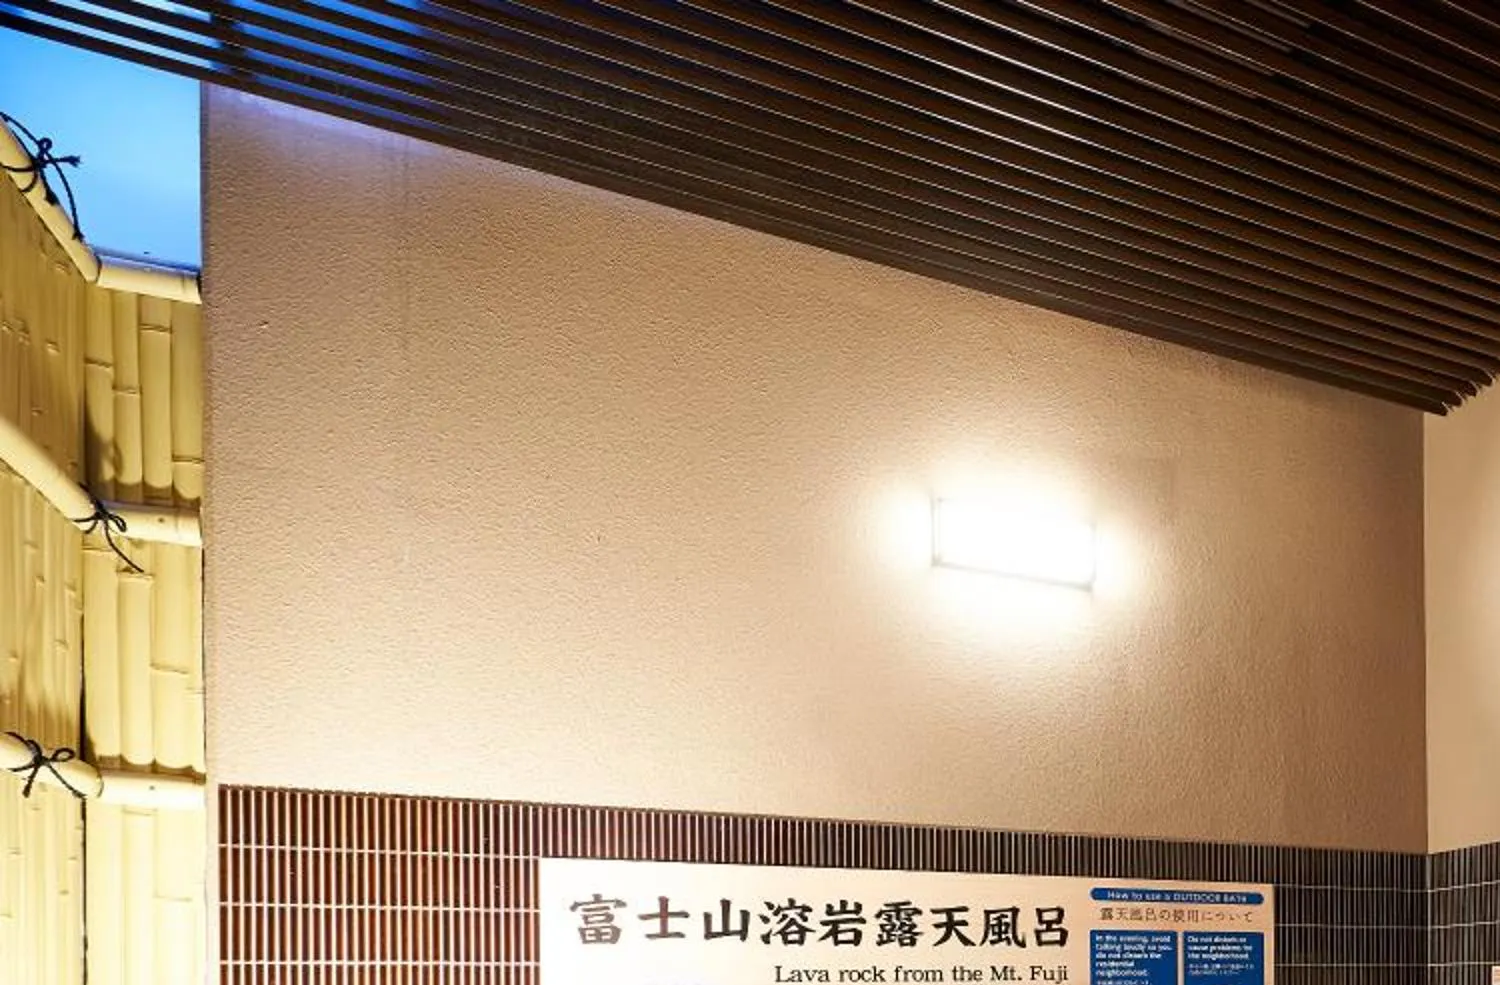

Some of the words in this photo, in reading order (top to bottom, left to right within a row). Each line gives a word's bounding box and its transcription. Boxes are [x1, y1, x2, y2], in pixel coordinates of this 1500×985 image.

[1107, 891, 1129, 900] How
[1131, 892, 1143, 900] to
[569, 893, 1071, 949] 富士山溶岩露天風呂
[1100, 907, 1254, 923] 露天風呂の使用について
[775, 965, 831, 984] Lava
[838, 964, 886, 984] rock
[894, 964, 944, 983] from
[951, 964, 984, 983] the
[990, 965, 1023, 982] Mt.
[1030, 964, 1070, 984] Fuji
